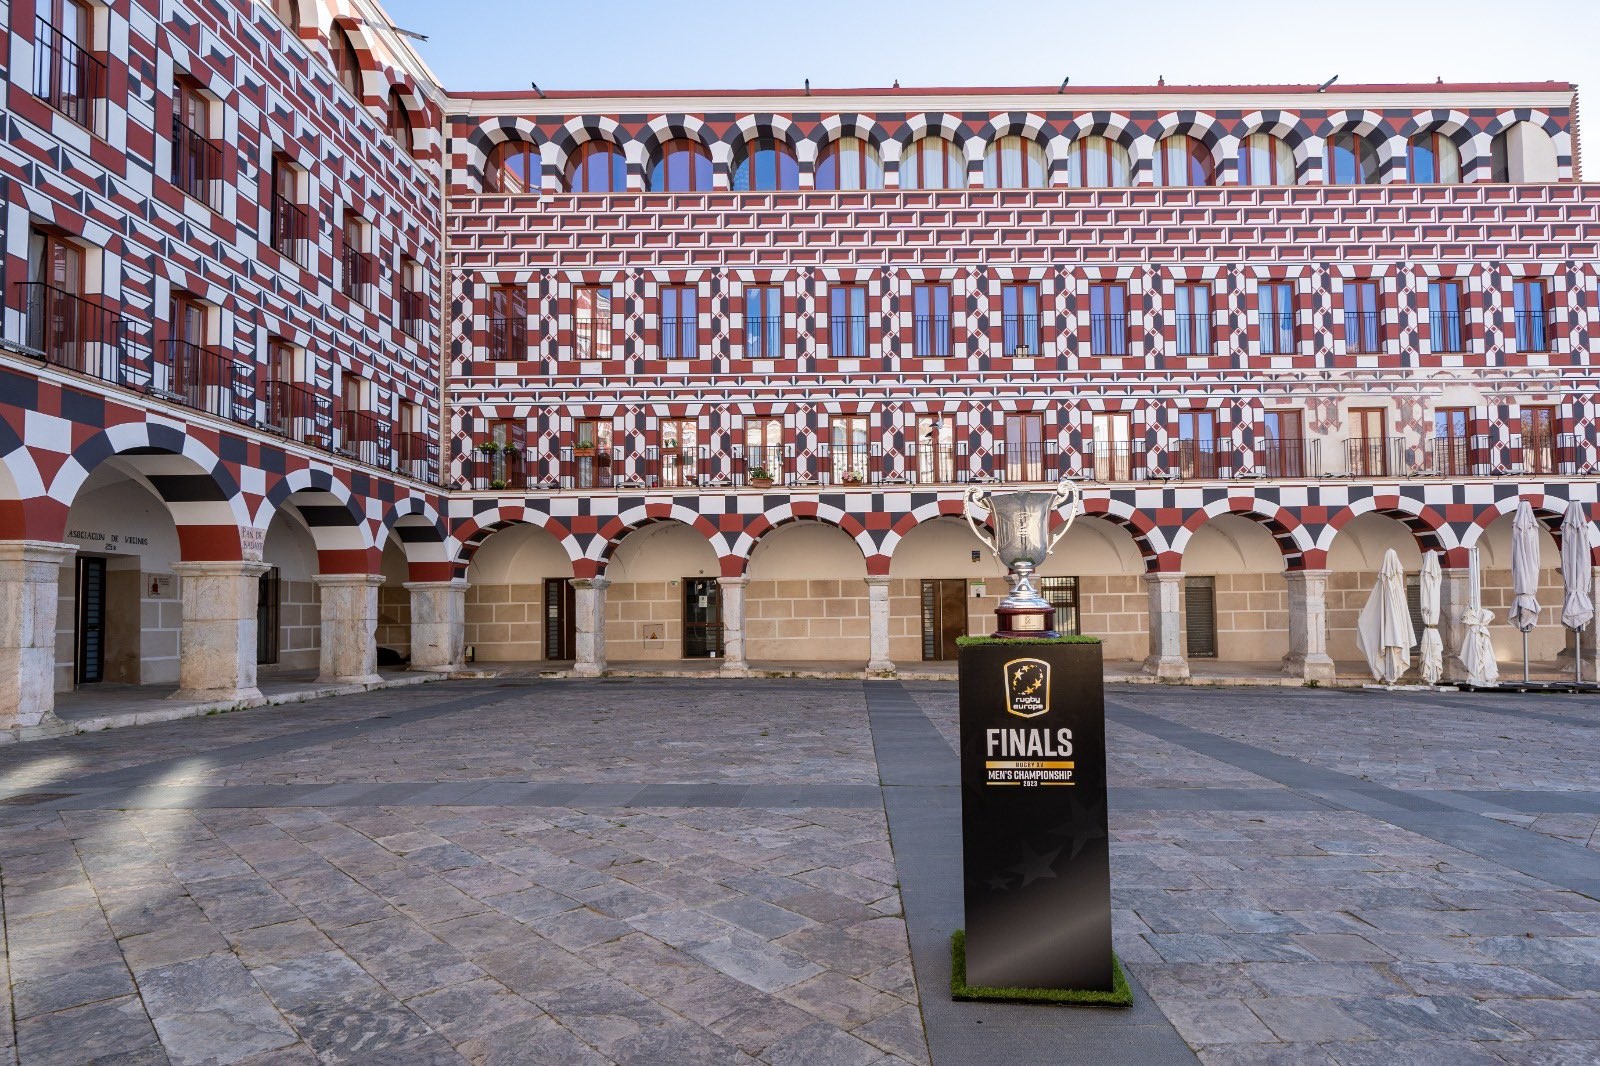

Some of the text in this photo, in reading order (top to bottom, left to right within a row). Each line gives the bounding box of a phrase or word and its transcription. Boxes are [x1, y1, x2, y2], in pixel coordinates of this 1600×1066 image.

[1015, 696, 1040, 704] rugby
[986, 728, 1073, 757] FINALS
[988, 770, 1073, 780] MEN'S CHAMPIONSHIP
